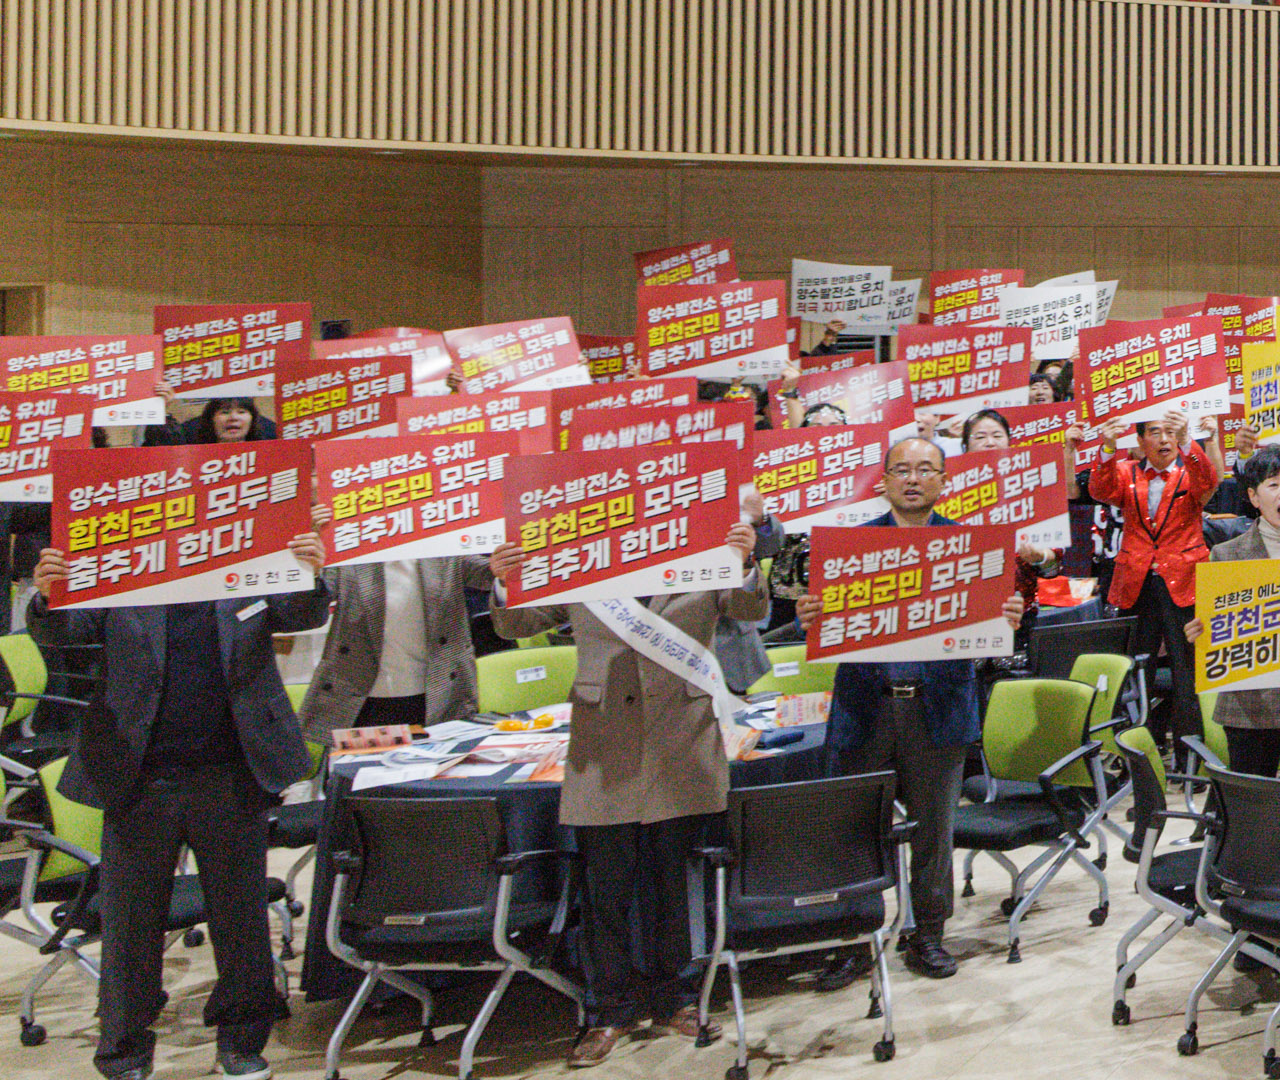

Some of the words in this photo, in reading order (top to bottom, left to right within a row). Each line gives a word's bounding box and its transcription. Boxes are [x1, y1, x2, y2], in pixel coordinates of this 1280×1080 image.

[643, 253, 689, 277] 양수발전소
[690, 244, 711, 259] 유치!
[695, 249, 730, 273] 모두를
[648, 296, 717, 323] 양수발전소
[721, 288, 753, 307] 유치!
[797, 286, 855, 300] 양수발전소
[860, 280, 884, 293] 유치
[648, 313, 720, 347] 합천군민
[725, 298, 779, 328] 모두를
[1089, 334, 1156, 367] 양수발전소
[1160, 323, 1191, 344] 유치!
[649, 340, 705, 371] 춤추게
[710, 328, 754, 356] 한다!
[1090, 351, 1160, 392] 합천군민
[1165, 334, 1217, 366] 모두를
[1093, 380, 1147, 417] 춤추게
[1151, 366, 1194, 397] 한다!
[69, 468, 192, 512] 양수발전소
[199, 452, 256, 485] 유치!
[520, 468, 630, 514] 양수발전소
[637, 452, 686, 484] 유치!
[68, 495, 196, 552] 합천군민
[206, 468, 298, 520] 모두를
[521, 494, 635, 553] 합천군민
[644, 468, 727, 518] 모두를
[68, 540, 166, 592] 춤추게
[178, 519, 254, 567] 한다!
[522, 538, 610, 591] 춤추게
[620, 517, 688, 563] 한다!
[681, 568, 731, 582] 합천군
[823, 545, 920, 580] 양수발전소
[926, 534, 971, 561] 유치!
[245, 570, 300, 586] 합천군
[822, 569, 922, 614] 합천군민
[930, 549, 1004, 592] 모두를
[1214, 588, 1253, 609] 친환경
[820, 607, 899, 648] 춤추게
[907, 591, 967, 630] 한다!
[959, 637, 1003, 648] 합천군
[1206, 633, 1277, 680] 강력히
